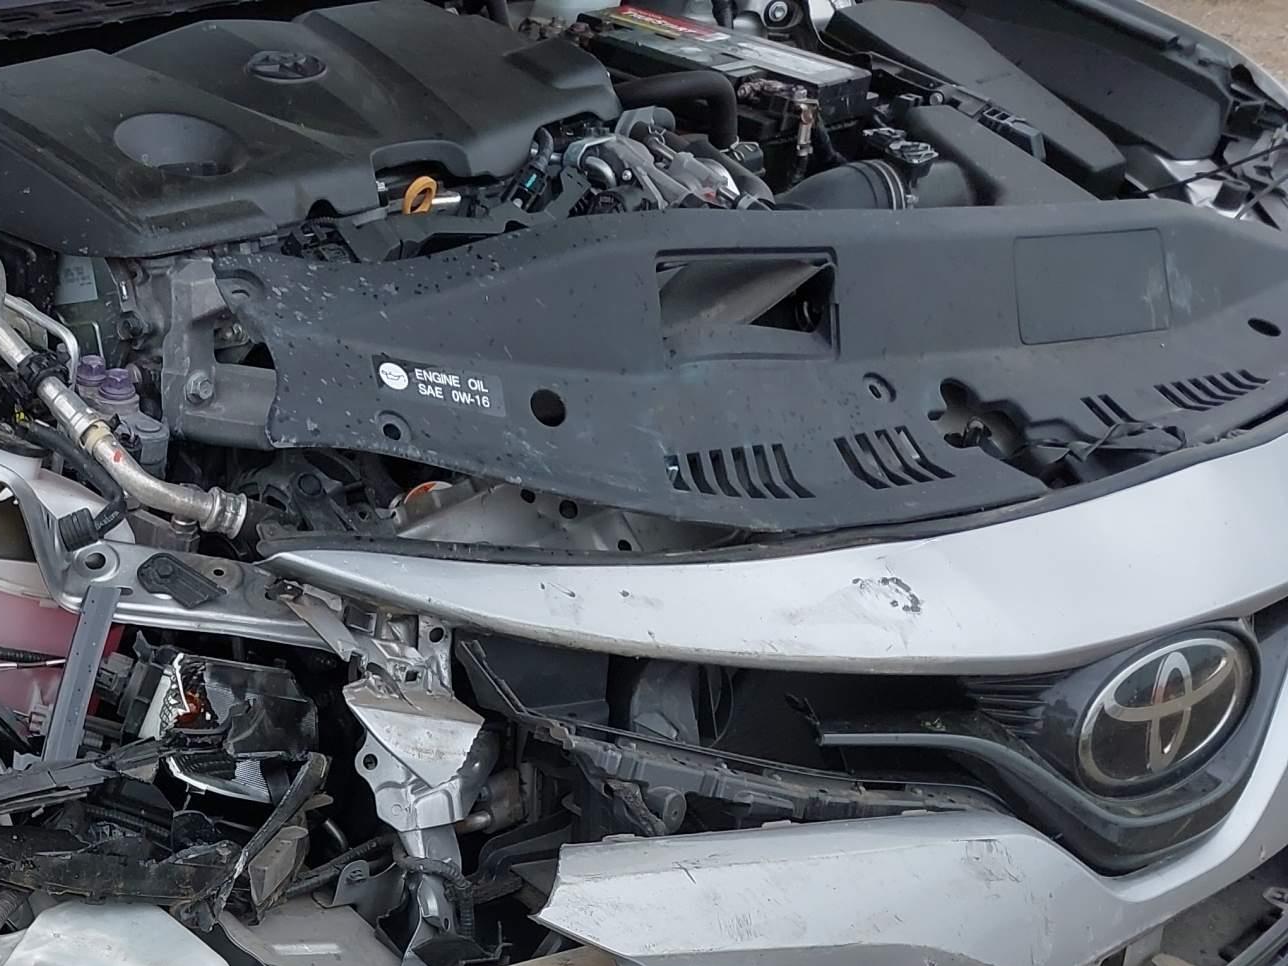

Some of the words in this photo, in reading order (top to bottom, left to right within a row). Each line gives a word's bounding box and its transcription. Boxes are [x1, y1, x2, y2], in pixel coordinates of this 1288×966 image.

[414, 367, 461, 388] ENGINE
[467, 378, 489, 393] OIL
[418, 383, 444, 399] SAE
[451, 389, 490, 408] 0W-16
